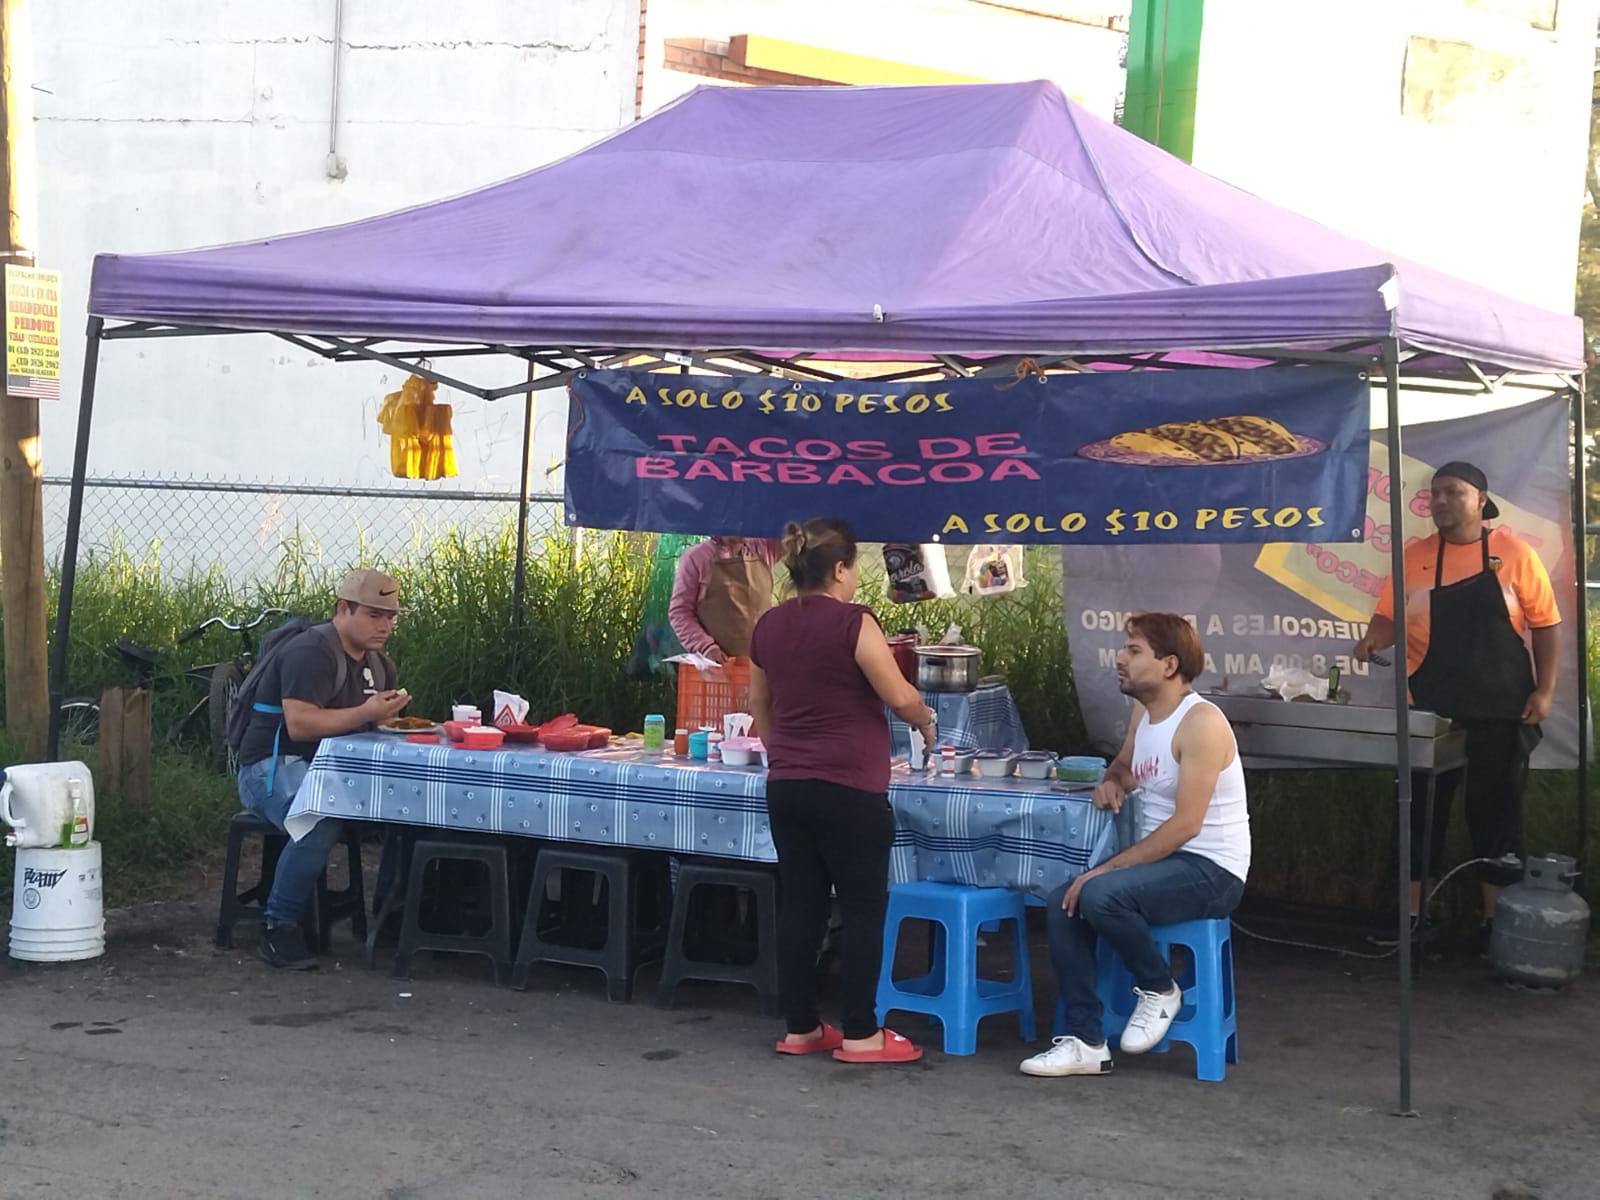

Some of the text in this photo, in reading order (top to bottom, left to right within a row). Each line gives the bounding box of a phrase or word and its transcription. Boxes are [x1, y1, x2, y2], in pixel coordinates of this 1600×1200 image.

[625, 385, 954, 414] A SOLO $10 PESOS
[657, 432, 1028, 461] TACOS DE
[635, 456, 1041, 486] BARBACOA
[942, 506, 1326, 536] A SOLO $10 PESOS
